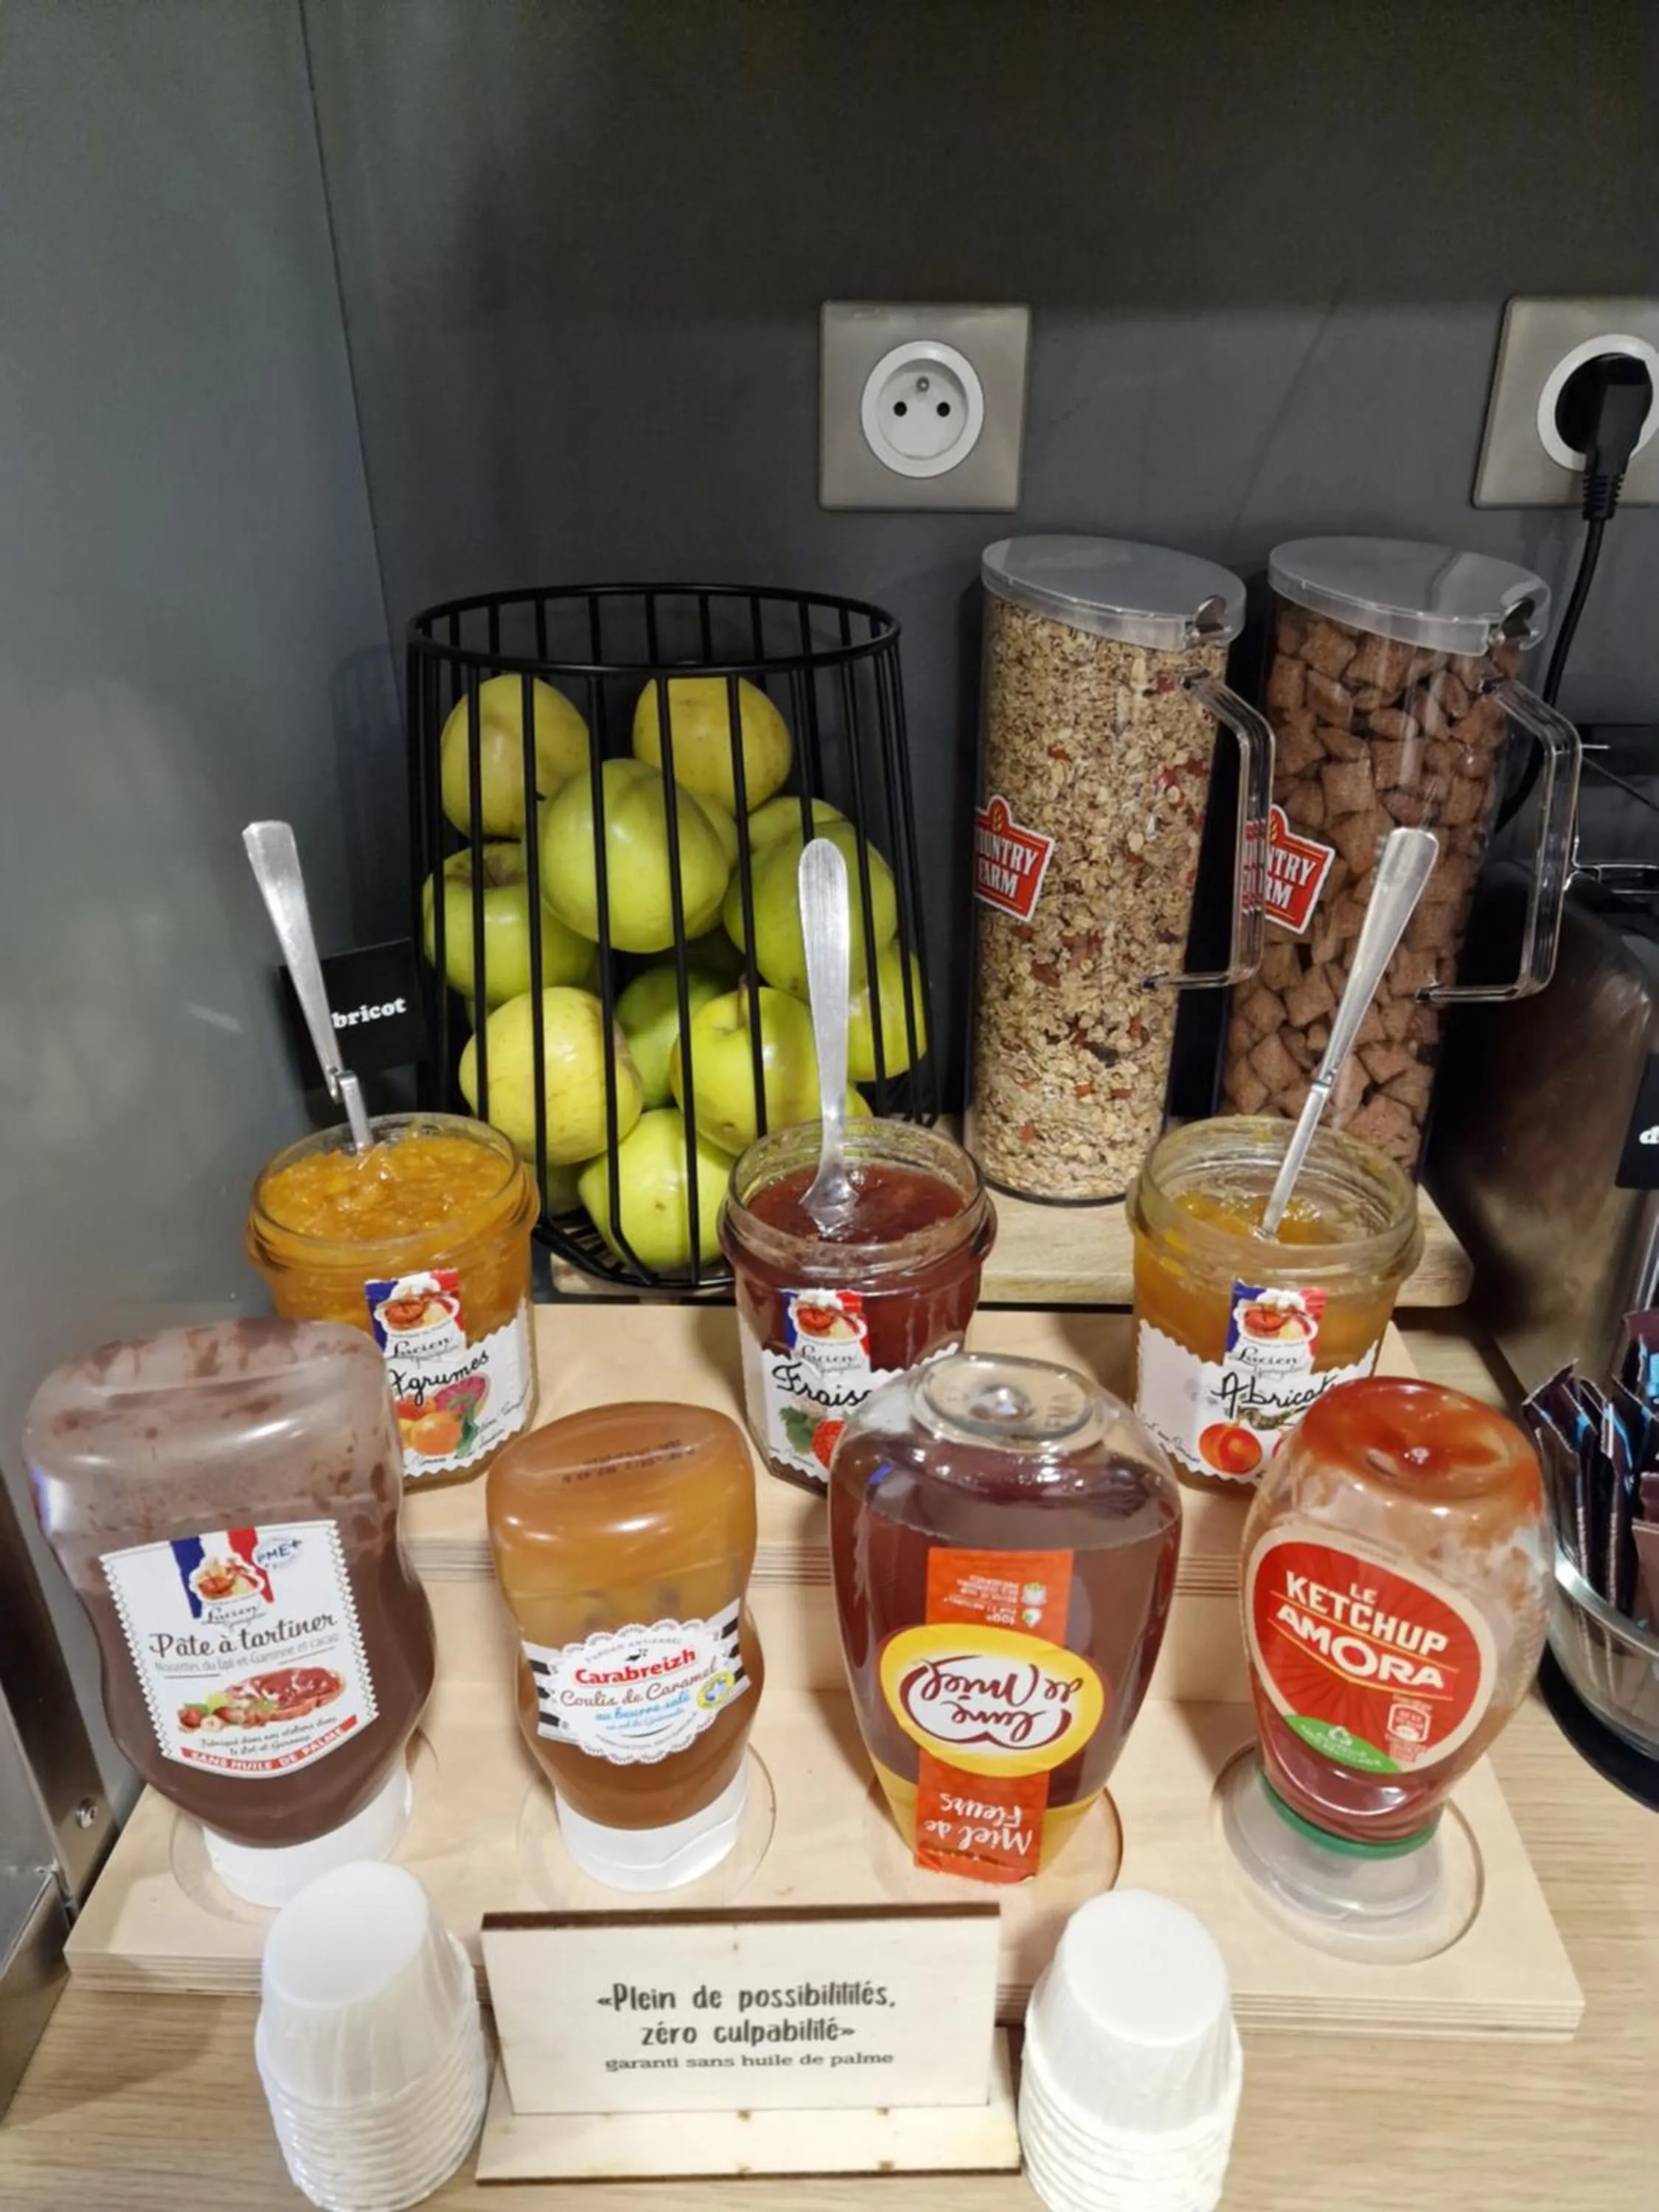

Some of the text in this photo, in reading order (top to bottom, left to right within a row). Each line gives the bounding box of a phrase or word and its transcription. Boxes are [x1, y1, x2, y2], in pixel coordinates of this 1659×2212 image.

[332, 998, 406, 1029] bricot
[772, 1363, 872, 1407] Frais
[1349, 1582, 1378, 1605] LE
[1285, 1570, 1450, 1657] KETCHUP
[149, 1632, 214, 1659] Pâte
[218, 1636, 237, 1654] à
[240, 1613, 338, 1651] tartiner
[1276, 1603, 1444, 1689] AMORA
[575, 1648, 696, 1685] Carabreizh
[1045, 1677, 1084, 1703] de
[230, 1759, 274, 1770] HUILE
[939, 1792, 1023, 1828] Fleurs
[925, 1819, 1033, 1856] Miel de
[692, 1984, 723, 2009] de
[641, 2020, 698, 2046] zéro
[605, 2051, 894, 2072] garanti sans huile de palme
